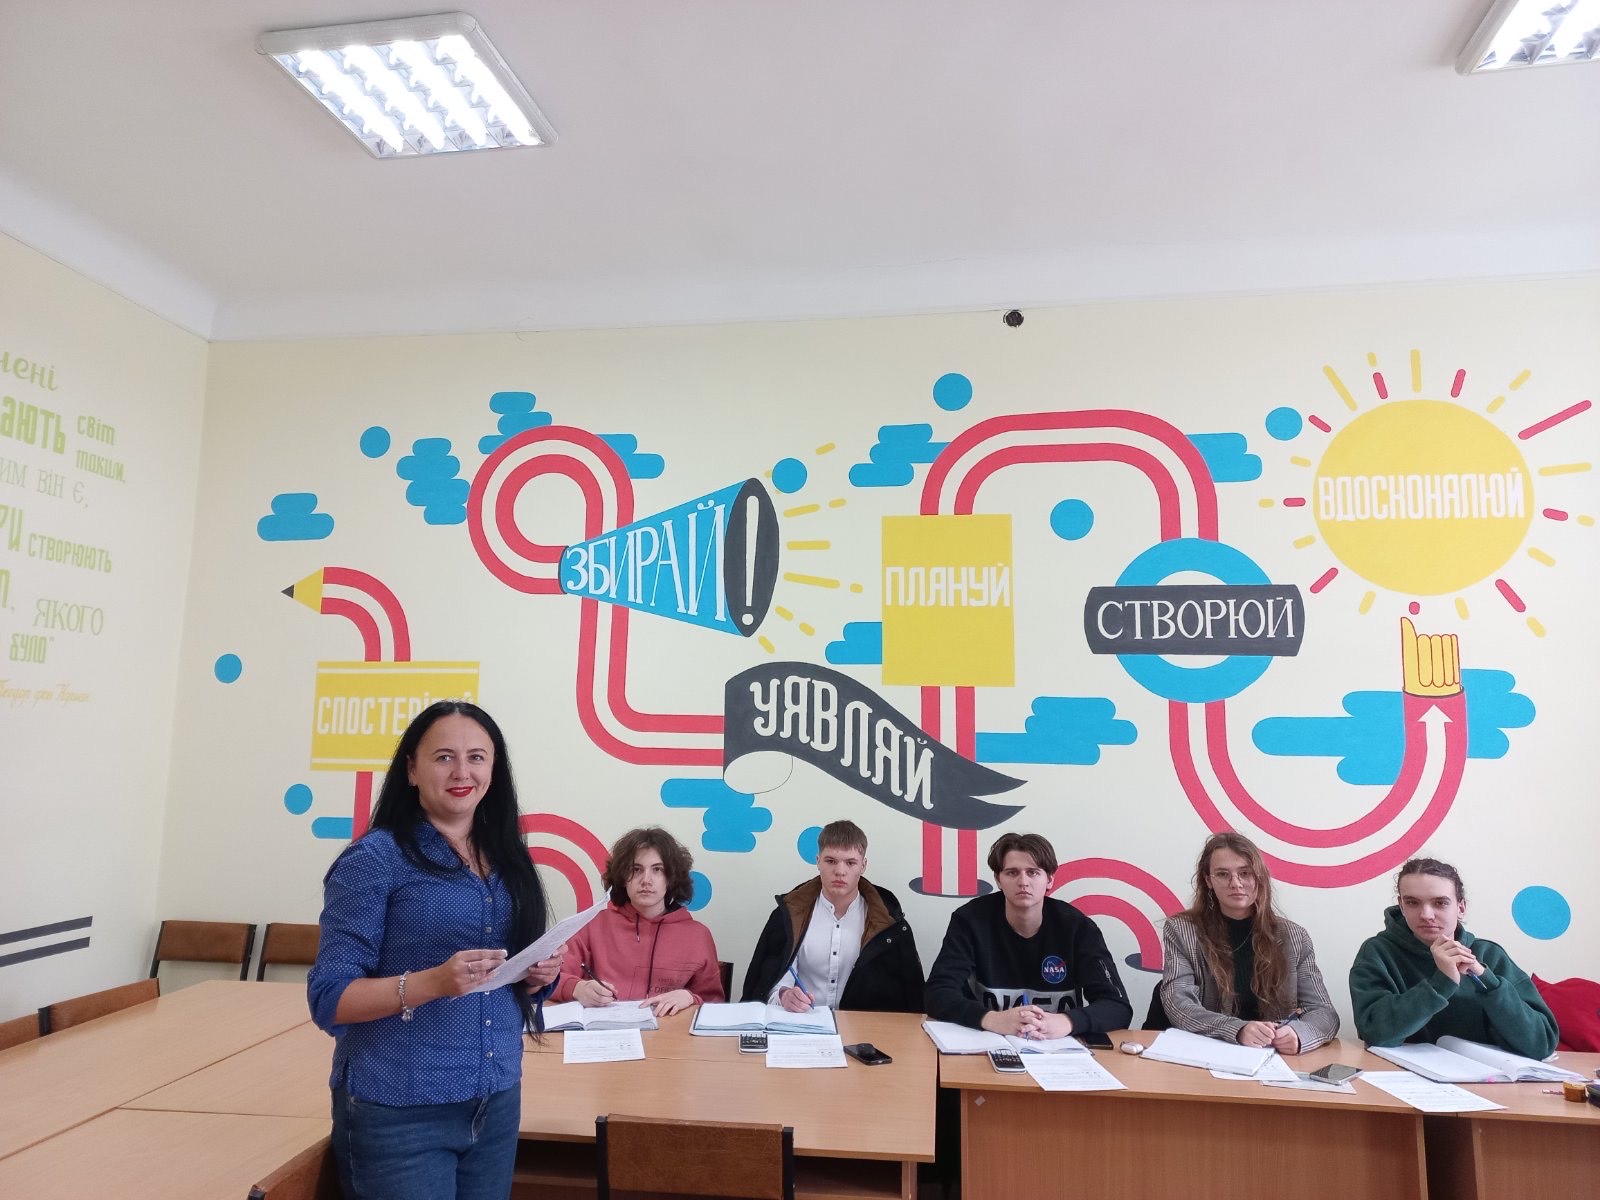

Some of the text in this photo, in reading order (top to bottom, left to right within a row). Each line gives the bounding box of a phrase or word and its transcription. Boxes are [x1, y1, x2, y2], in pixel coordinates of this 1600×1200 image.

[77, 415, 116, 446] світ
[1318, 467, 1524, 521] ВДОСКОНАЛЮЙ
[28, 533, 112, 573] СТВОРЮЮТЬ
[885, 562, 1011, 607] ПЛАНУЙ
[33, 598, 104, 636] ЯКОГО
[1097, 597, 1296, 640] СТВОРЮЙ
[316, 692, 473, 735] СПОСТЕР
[750, 675, 934, 809] УЯВЛЯЙ
